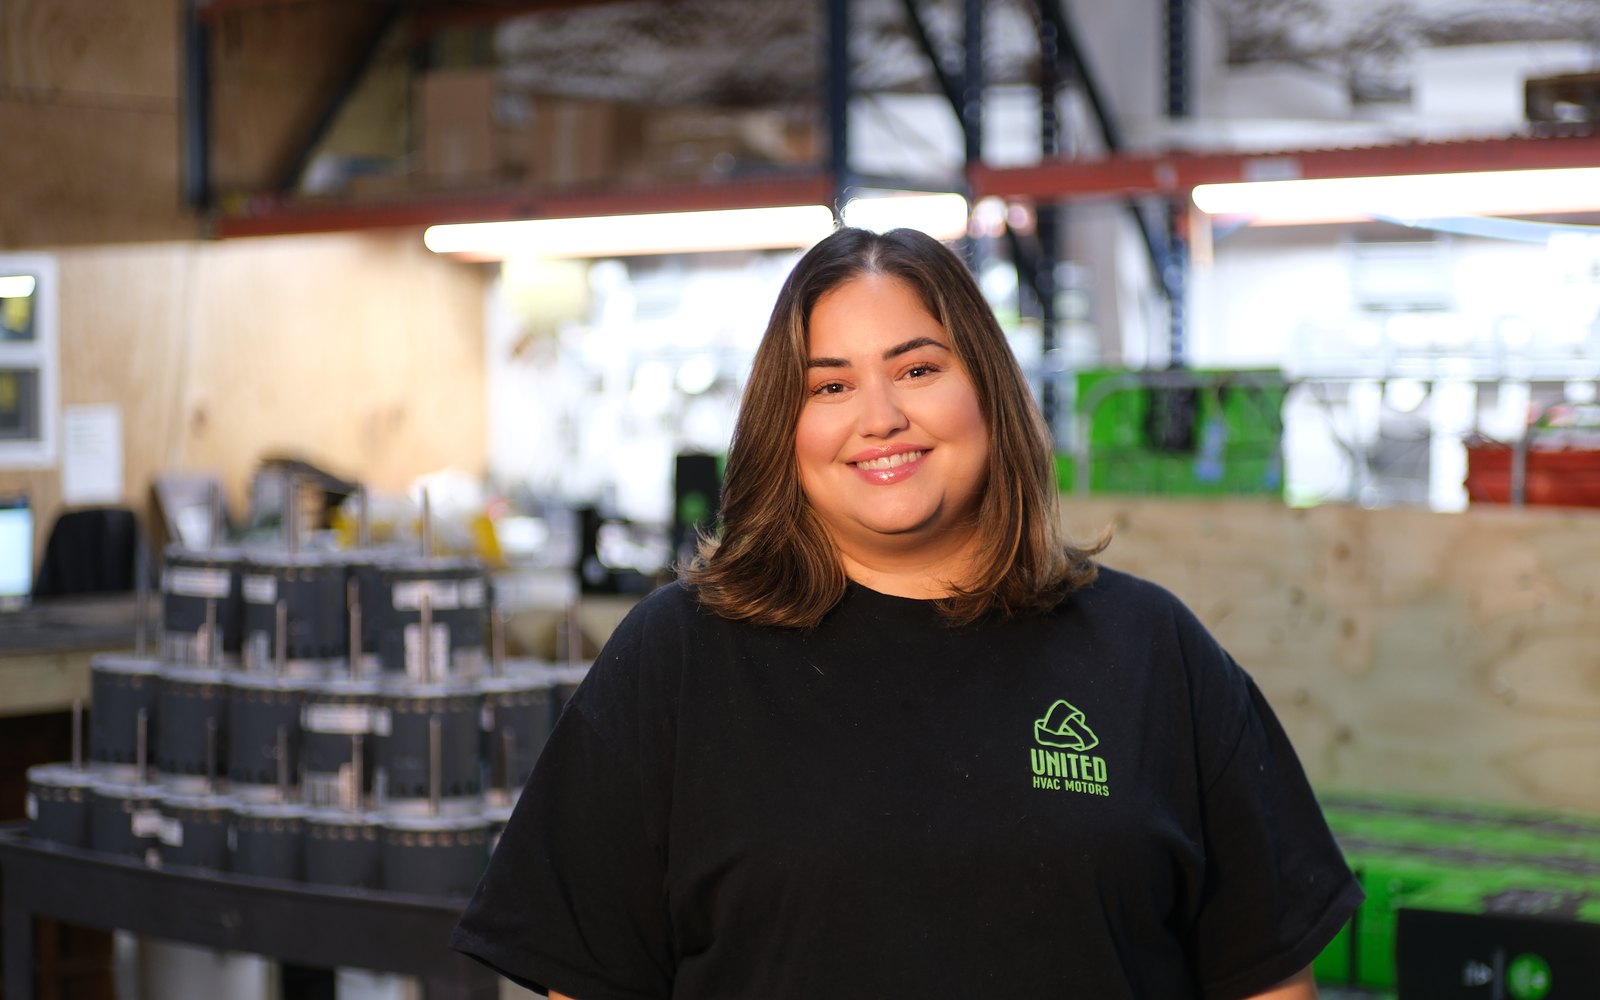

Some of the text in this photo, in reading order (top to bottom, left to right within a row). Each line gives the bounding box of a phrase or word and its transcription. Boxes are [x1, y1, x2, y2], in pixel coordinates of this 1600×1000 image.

[1031, 749, 1107, 782] UNITED
[1033, 776, 1109, 796] HVAC MOTORS
